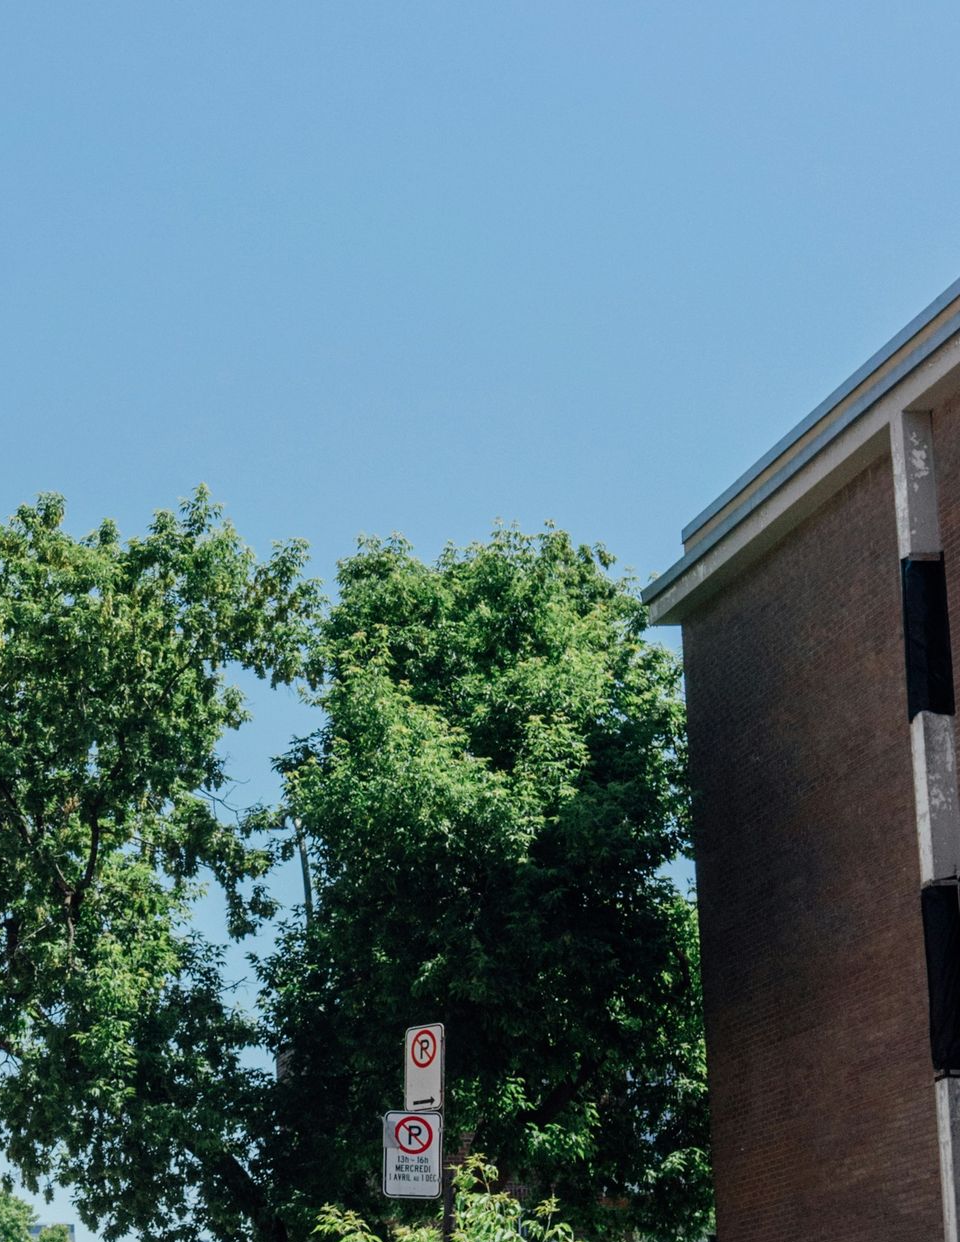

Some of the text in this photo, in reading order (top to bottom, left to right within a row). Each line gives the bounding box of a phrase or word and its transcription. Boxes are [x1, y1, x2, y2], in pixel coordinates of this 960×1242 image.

[408, 1125, 422, 1146] P
[395, 1164, 431, 1173] MERCREDI
[394, 1173, 411, 1181] AVRIL
